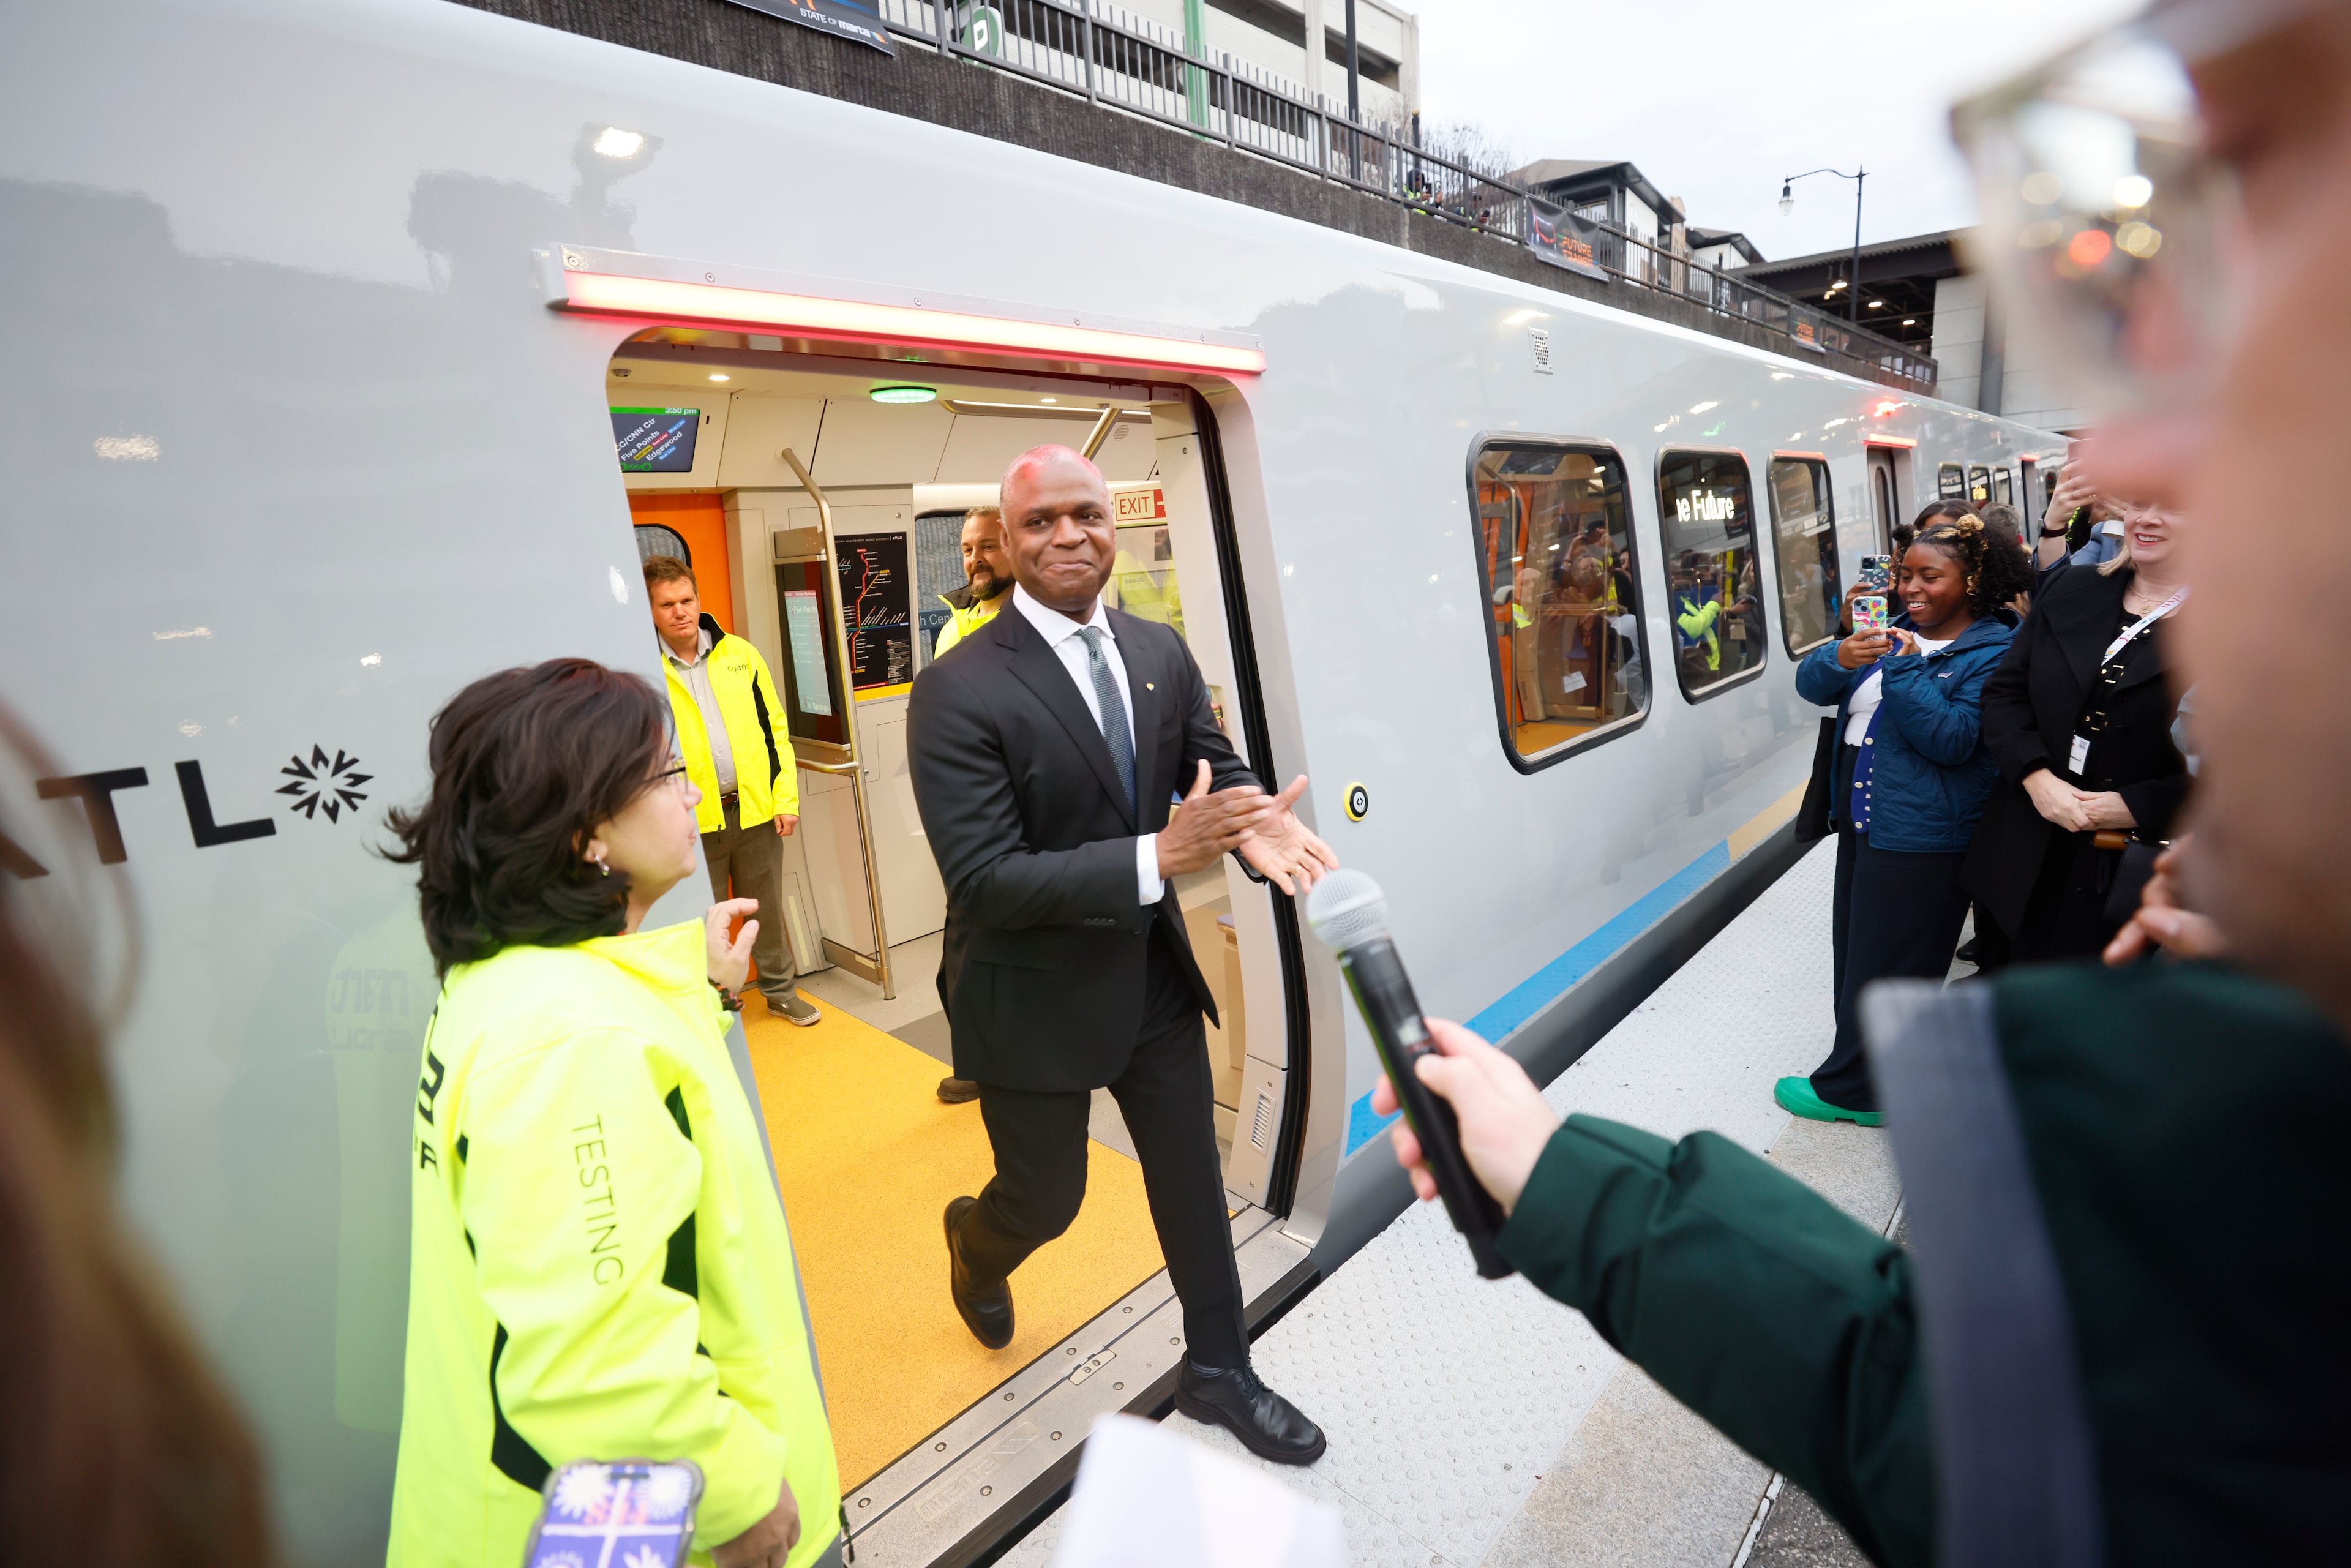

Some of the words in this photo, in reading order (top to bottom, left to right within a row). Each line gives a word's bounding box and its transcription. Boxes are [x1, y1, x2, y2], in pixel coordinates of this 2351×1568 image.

[800, 7, 827, 24] STATE
[828, 17, 838, 26] OF
[838, 20, 871, 37] marta
[643, 418, 657, 429] Ctr
[621, 448, 637, 461] Five
[636, 430, 660, 449] Points
[645, 431, 683, 462] Edgewood
[1120, 496, 1150, 514] EXIT
[1692, 490, 1734, 521] Future
[727, 663, 748, 673] CQ40
[812, 702, 830, 712] Springs
[571, 1113, 624, 1286] TESTING
